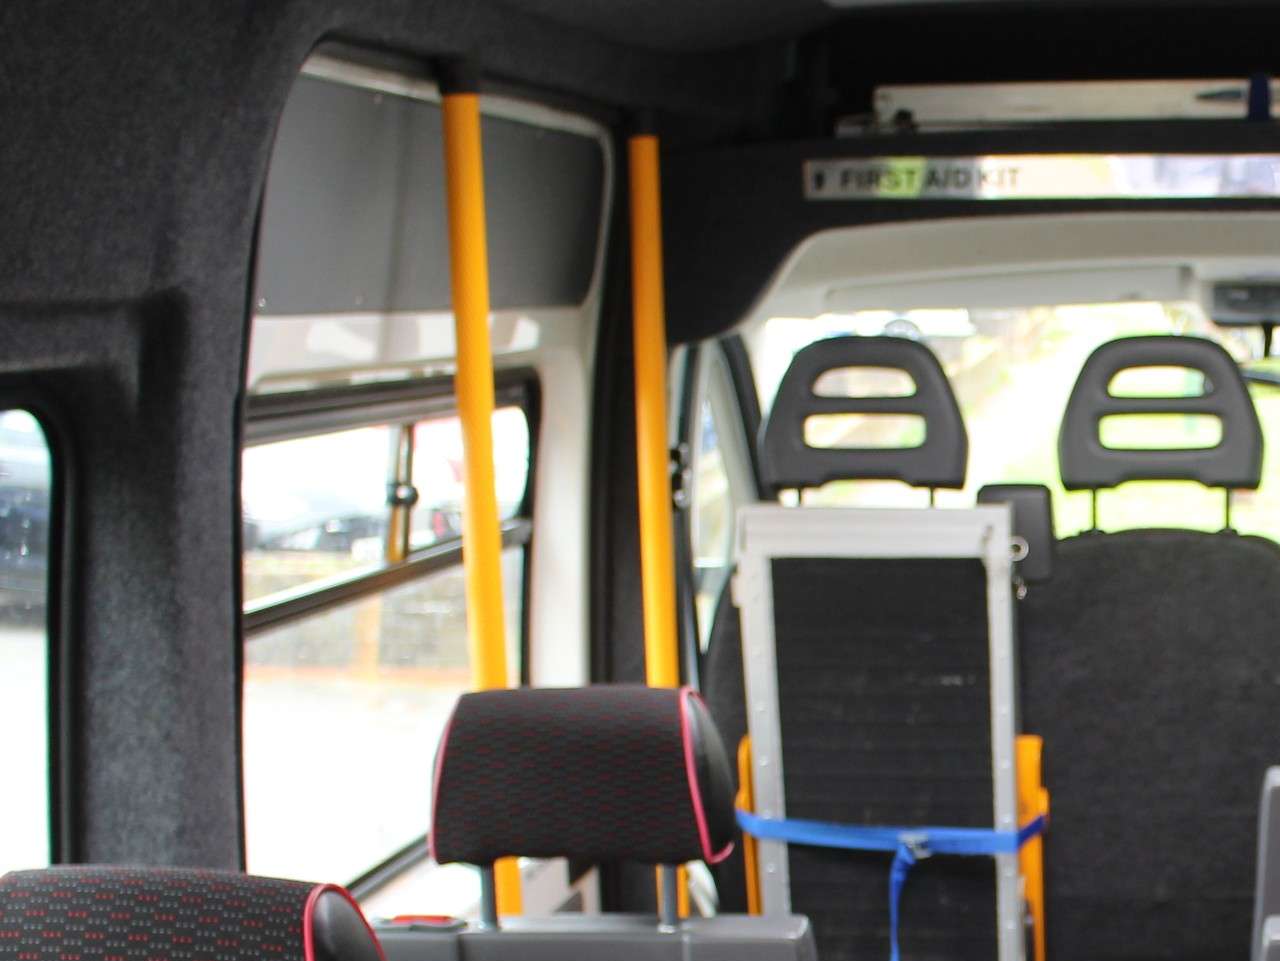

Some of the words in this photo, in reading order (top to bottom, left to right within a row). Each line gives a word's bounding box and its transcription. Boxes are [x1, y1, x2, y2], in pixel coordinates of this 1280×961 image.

[839, 166, 917, 189] FIRST
[924, 165, 970, 188] AID
[977, 166, 1019, 188] KIT
